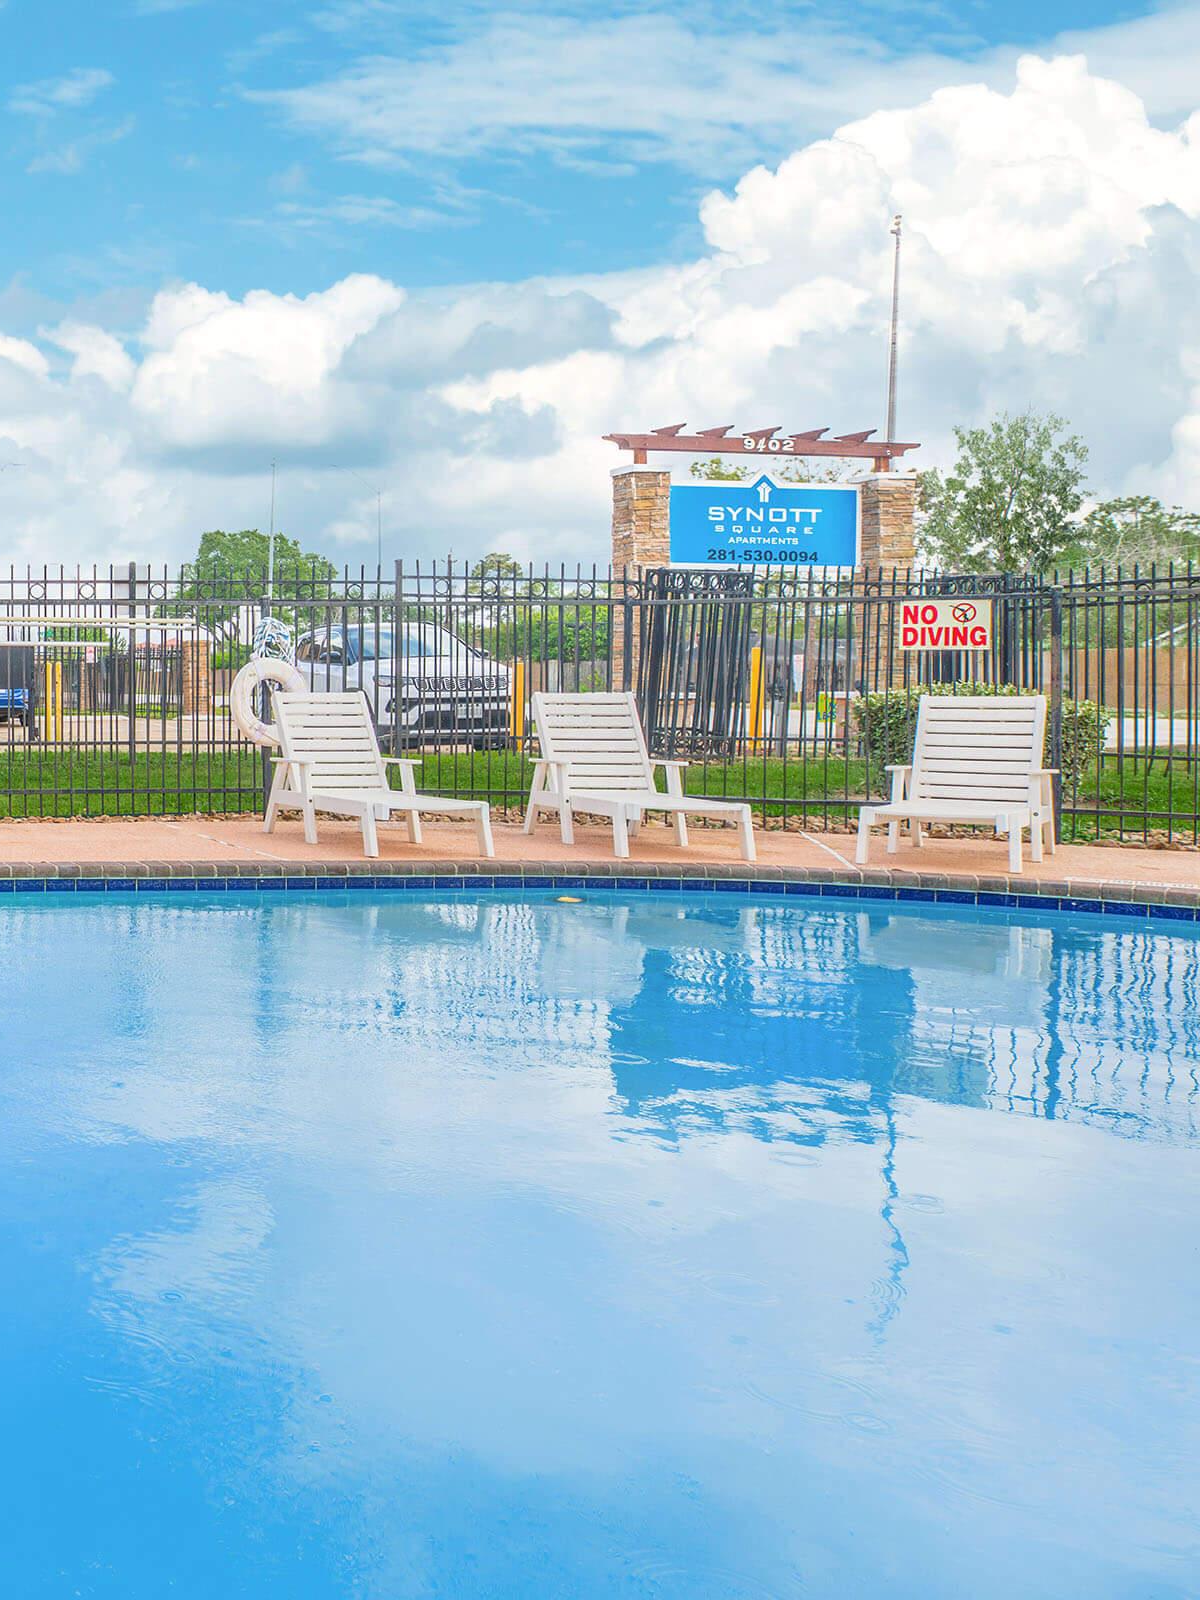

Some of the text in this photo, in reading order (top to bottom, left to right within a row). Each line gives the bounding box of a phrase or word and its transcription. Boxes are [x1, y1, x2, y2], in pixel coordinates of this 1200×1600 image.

[743, 437, 795, 452] 9402
[707, 506, 822, 523] SYNOTT
[714, 525, 814, 535] SQUARE
[728, 537, 799, 545] APARTMENTS
[707, 549, 819, 563] 281-530.0094
[903, 604, 938, 625] NO
[902, 626, 987, 647] DIVING
